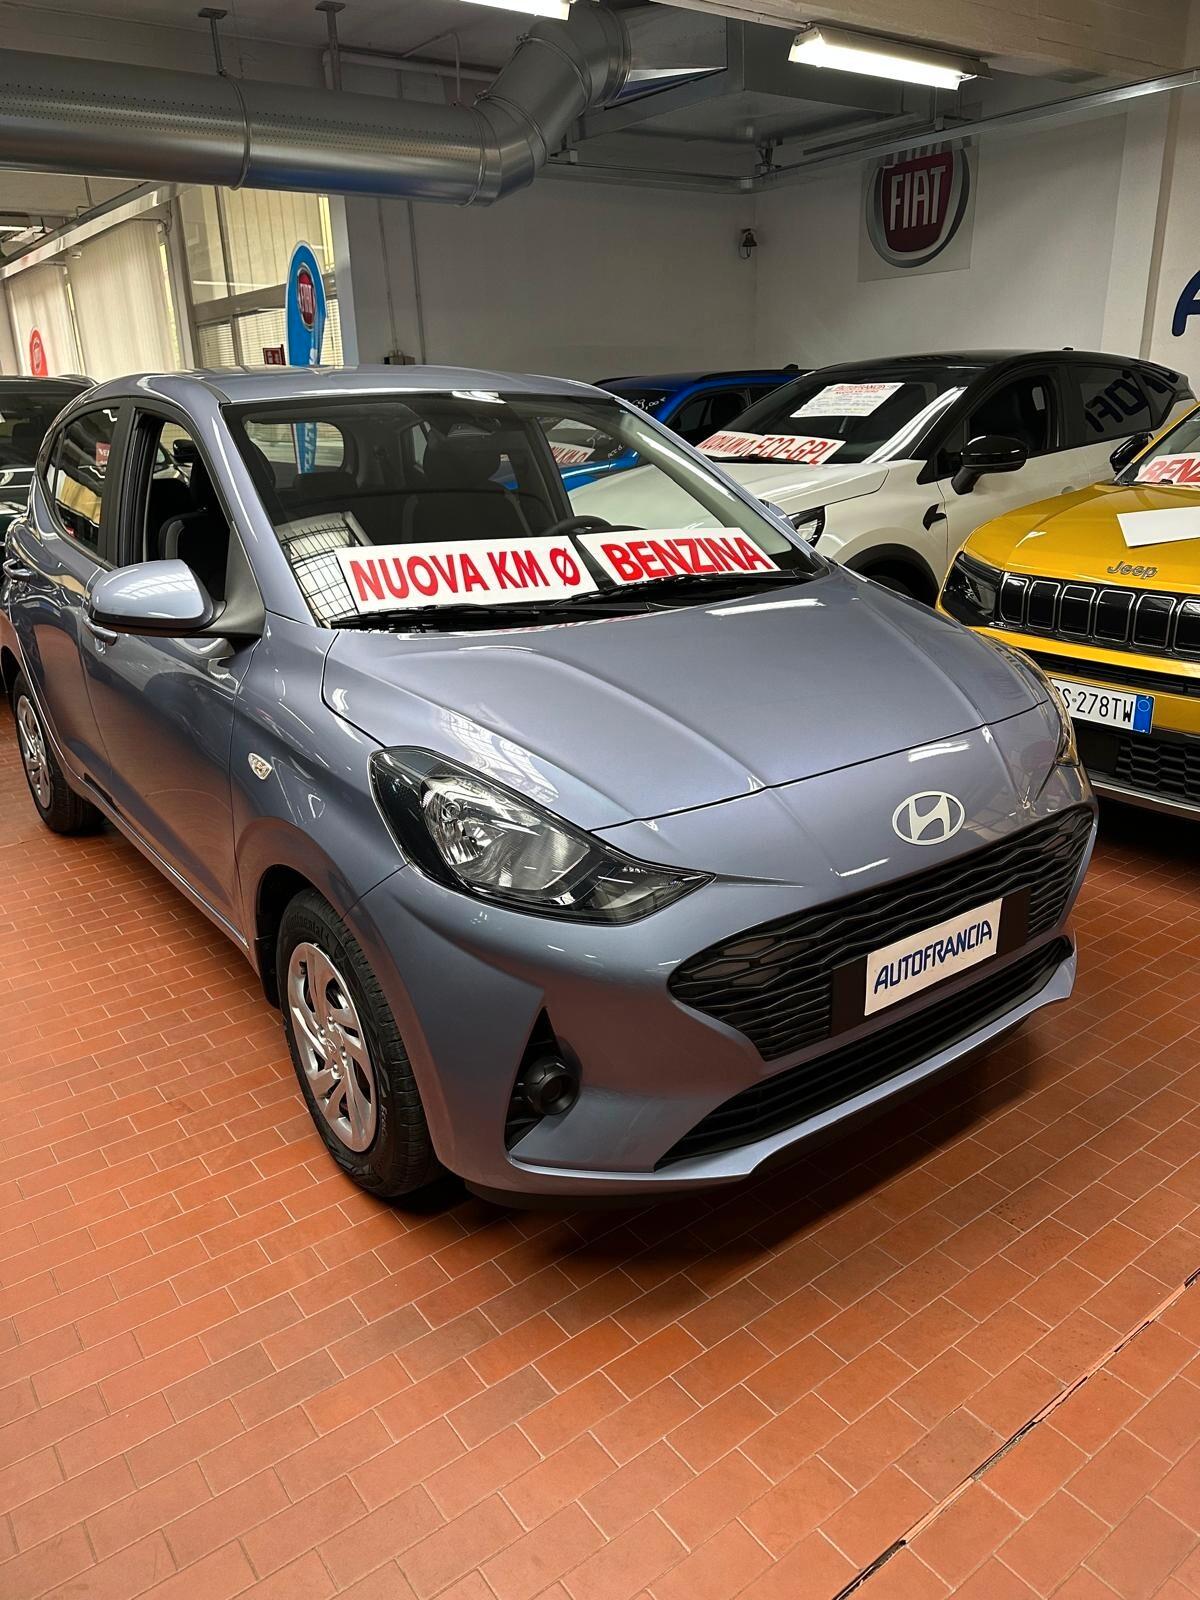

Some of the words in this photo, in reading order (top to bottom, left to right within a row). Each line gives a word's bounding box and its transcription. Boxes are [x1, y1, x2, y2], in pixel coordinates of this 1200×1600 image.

[890, 165, 946, 231] FIAT
[746, 438, 836, 465] ECO-GPL
[349, 553, 485, 601] NUOVA
[486, 551, 550, 590] KM
[601, 537, 775, 582] BENZINA
[1107, 561, 1158, 579] Jeep
[874, 920, 992, 994] AUTOFRANCIA
